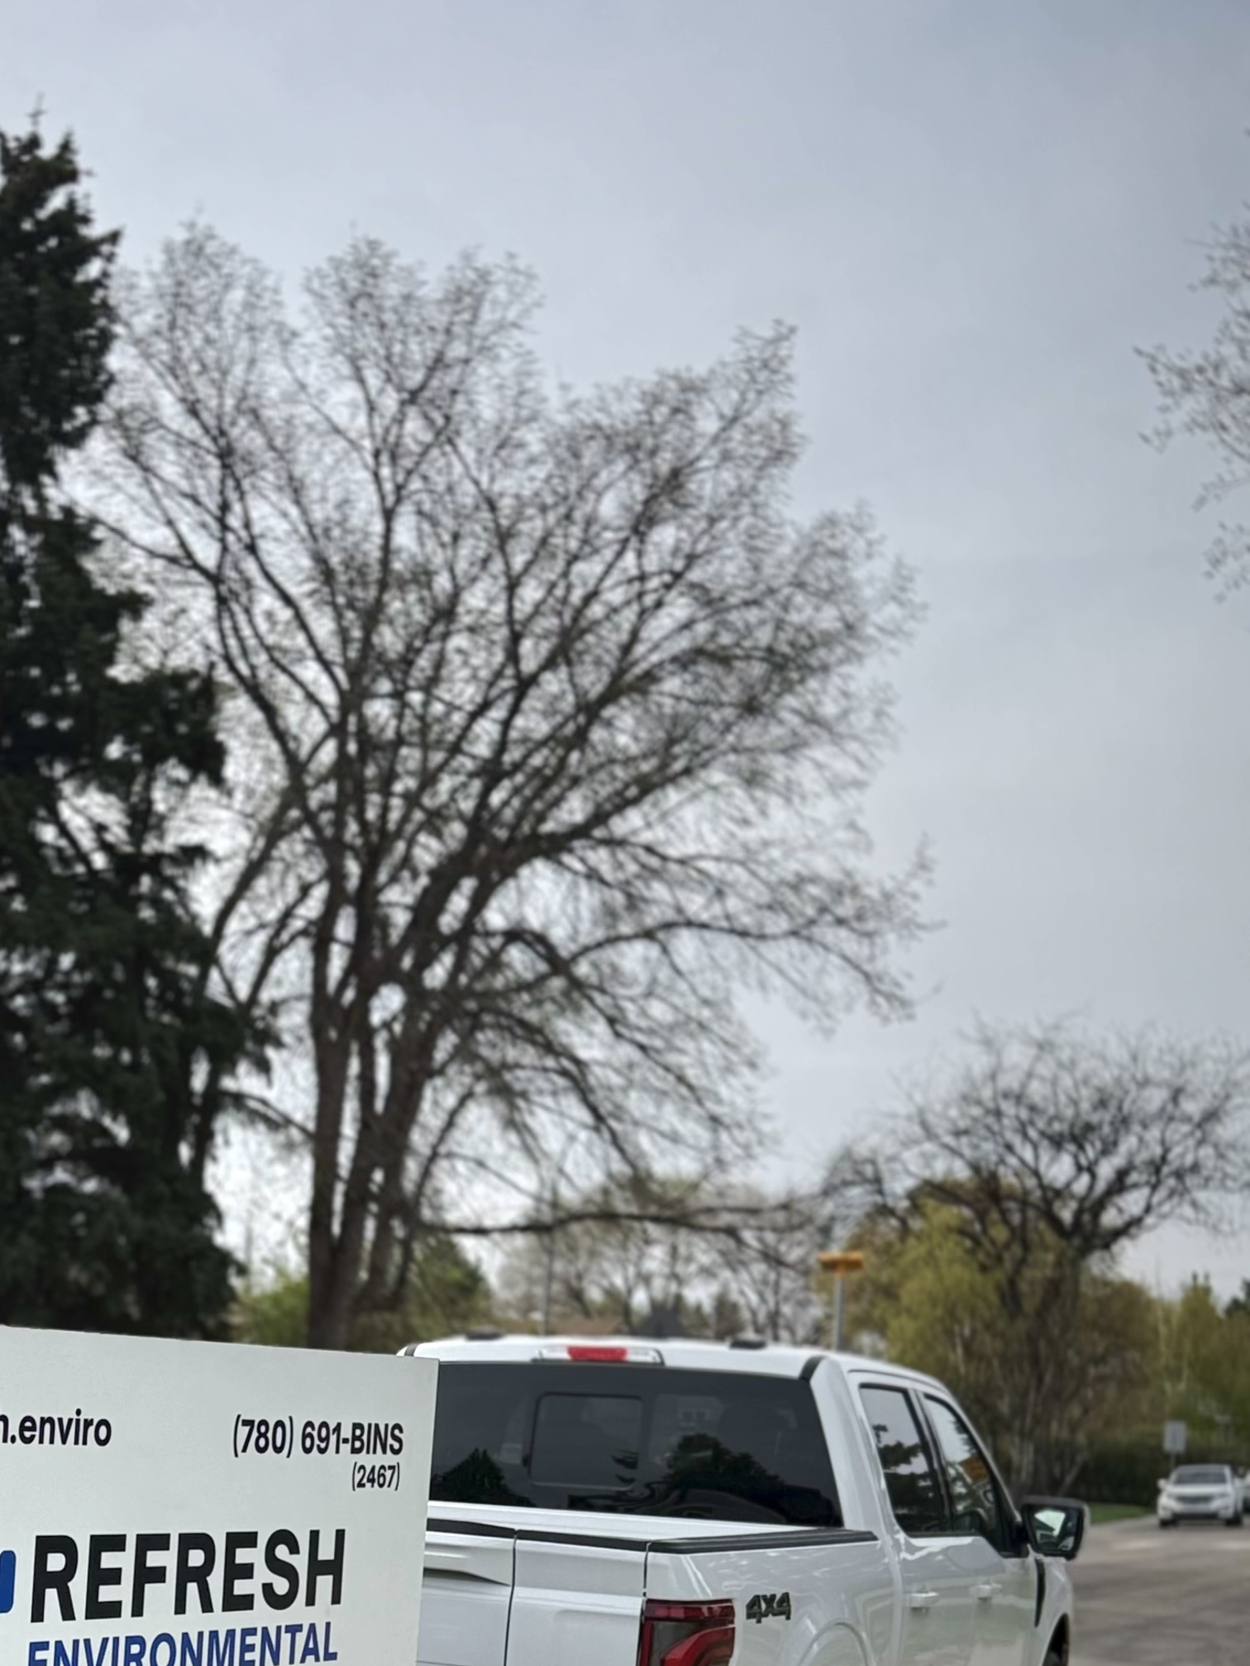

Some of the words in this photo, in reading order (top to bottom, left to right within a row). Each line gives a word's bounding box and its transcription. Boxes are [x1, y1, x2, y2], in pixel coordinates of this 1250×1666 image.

[233, 1414, 294, 1458] (780)
[301, 1420, 404, 1456] 691-BINS
[352, 1461, 400, 1491] (2467)
[30, 1529, 346, 1623] REFRESH
